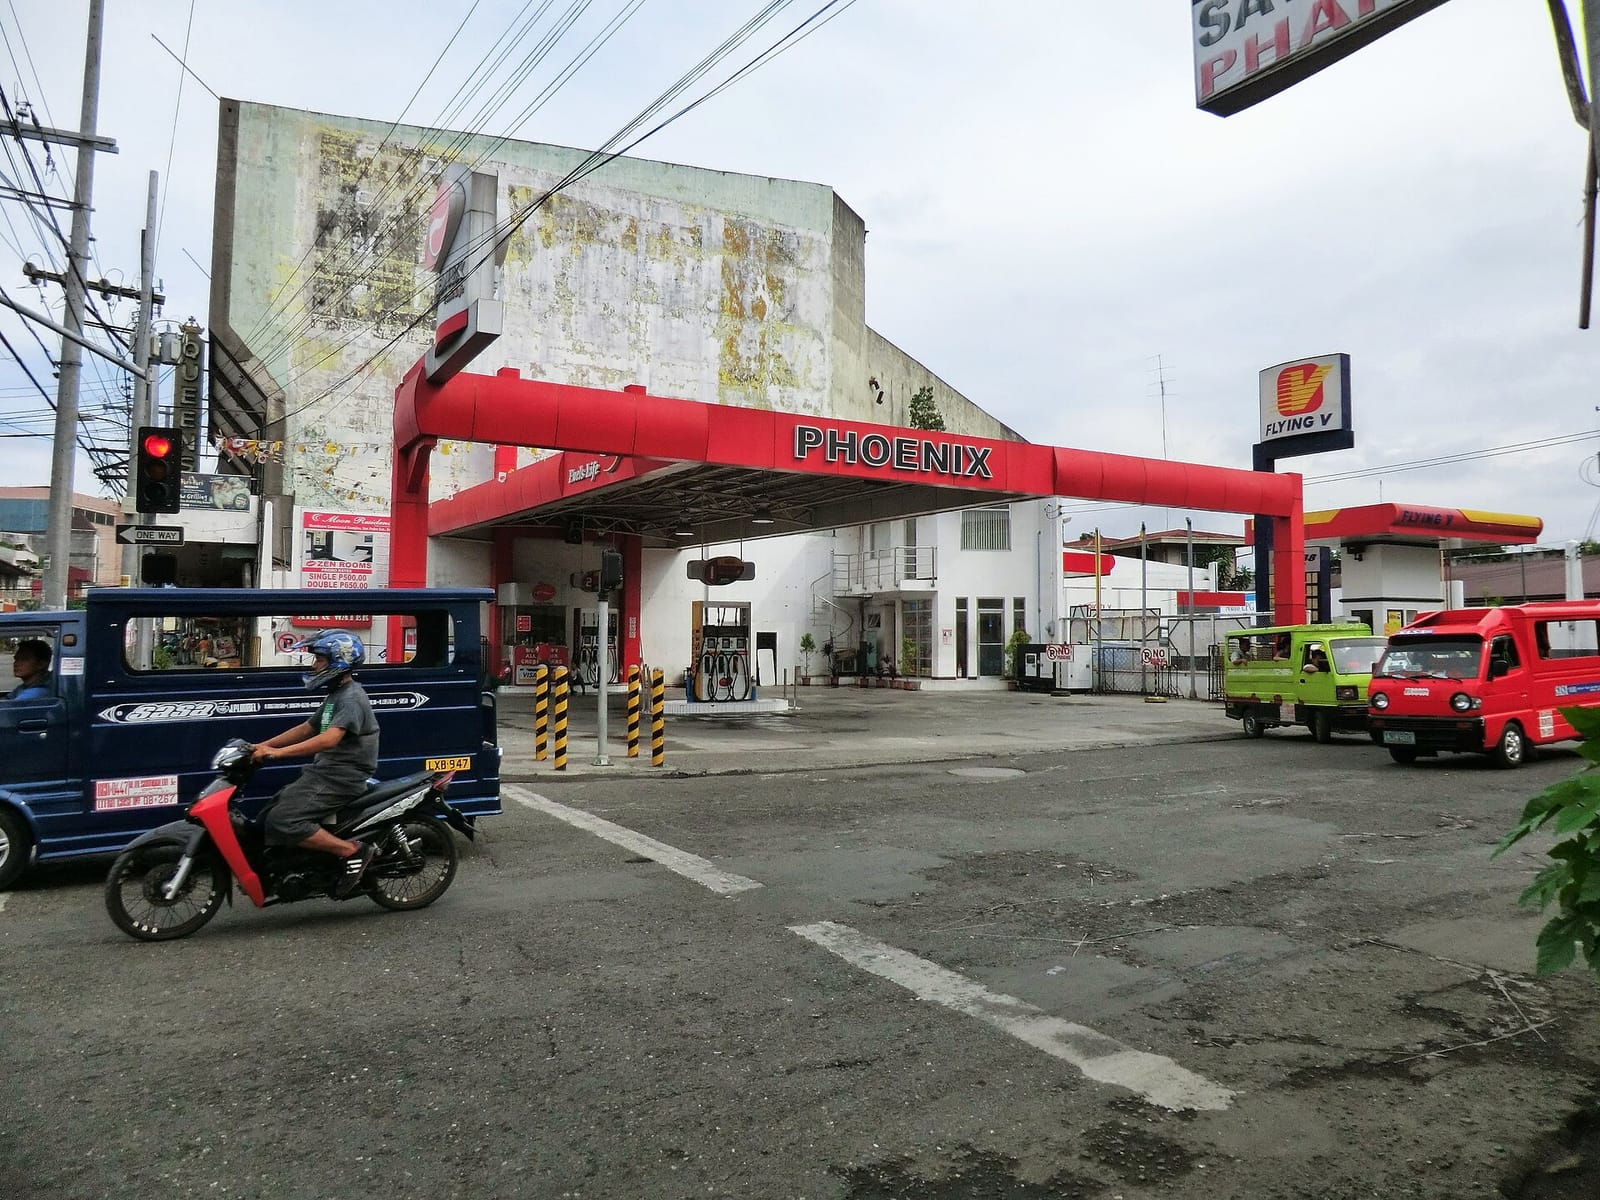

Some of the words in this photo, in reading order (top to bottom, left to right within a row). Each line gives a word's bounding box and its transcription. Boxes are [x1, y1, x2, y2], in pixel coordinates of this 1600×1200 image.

[1199, 0, 1290, 47] SA
[181, 341, 201, 472] QUEENS
[1265, 416, 1314, 436] FLYING
[1320, 413, 1333, 426] V
[794, 425, 993, 478] PHOENIX
[322, 515, 350, 523] Moon
[1402, 510, 1442, 525] FLYING
[1445, 515, 1454, 525] V
[136, 531, 154, 539] ONE
[158, 531, 177, 539] WAY
[585, 577, 593, 587] 2
[1058, 647, 1070, 655] NO
[1153, 649, 1165, 657] NO
